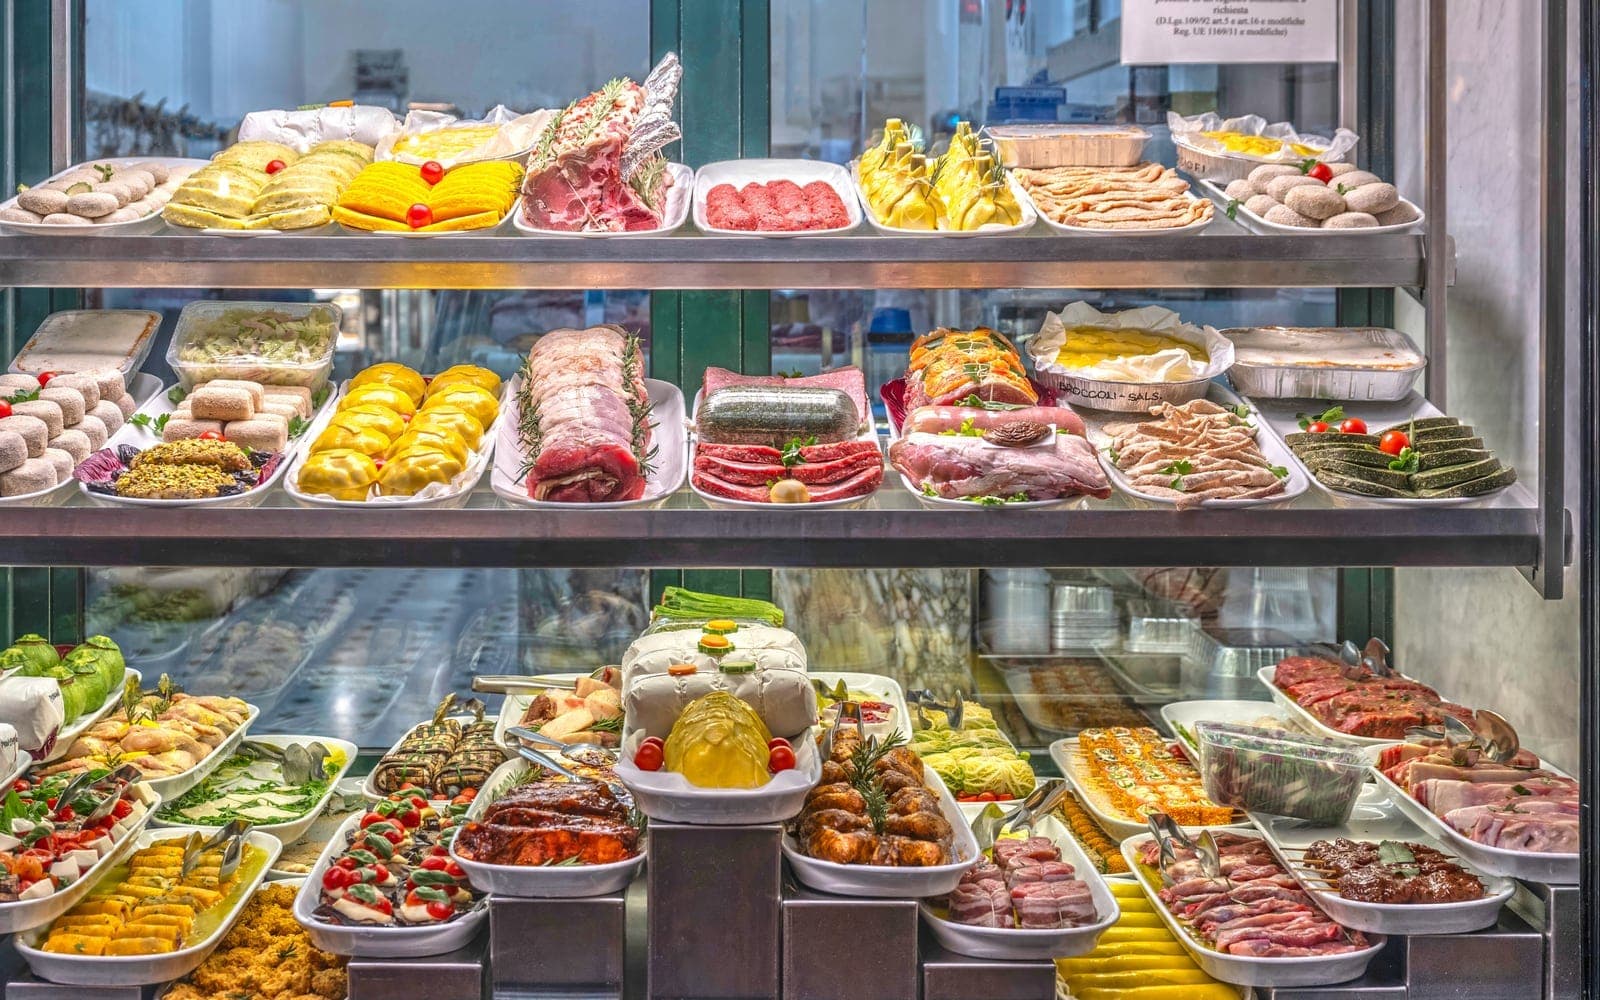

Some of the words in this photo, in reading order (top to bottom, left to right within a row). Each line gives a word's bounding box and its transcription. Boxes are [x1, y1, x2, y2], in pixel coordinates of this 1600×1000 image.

[1213, 5, 1249, 14] richiesta
[1237, 16, 1260, 25] art.16
[1267, 16, 1306, 25] modifiche
[1173, 27, 1191, 37] Reg.
[1193, 27, 1206, 36] UE
[1246, 27, 1289, 38] modifiche)
[1059, 381, 1117, 400] BROCCOLI
[1127, 391, 1163, 402] SALS.
